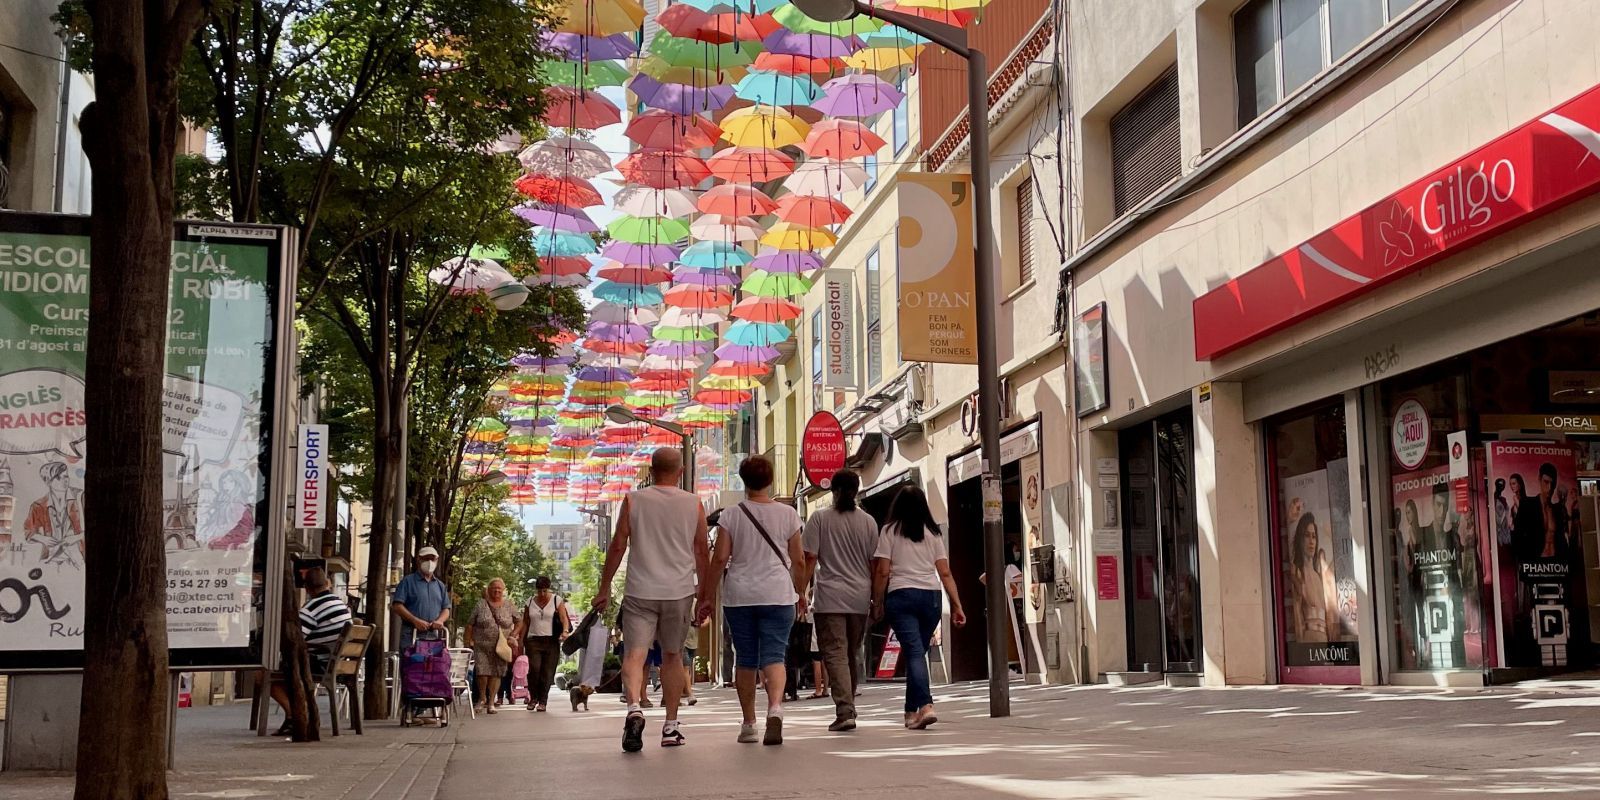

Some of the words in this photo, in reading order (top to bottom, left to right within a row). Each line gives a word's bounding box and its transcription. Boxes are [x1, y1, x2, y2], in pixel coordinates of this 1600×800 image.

[200, 226, 227, 234] ALPHA
[172, 252, 235, 275] CIAL
[929, 314, 947, 322] FEM
[828, 280, 844, 375] studiogestalt
[929, 322, 948, 330] BON
[16, 340, 69, 353] d'agost
[930, 339, 949, 347] SOM
[930, 347, 971, 355] FORNERS
[175, 403, 184, 411] el
[1544, 416, 1598, 428] L'ORÉAL
[806, 443, 843, 451] PASSION
[1496, 446, 1527, 455] paco
[1528, 446, 1572, 456] rabanne
[303, 428, 321, 527] INTERSPORT
[1395, 480, 1420, 494] paco
[1414, 549, 1457, 565] PHANTOM
[1523, 563, 1569, 573] PHANTOM
[180, 579, 193, 589] 54
[197, 579, 210, 589] 27
[214, 579, 228, 589] 99
[1309, 645, 1350, 662] LANCÔME
